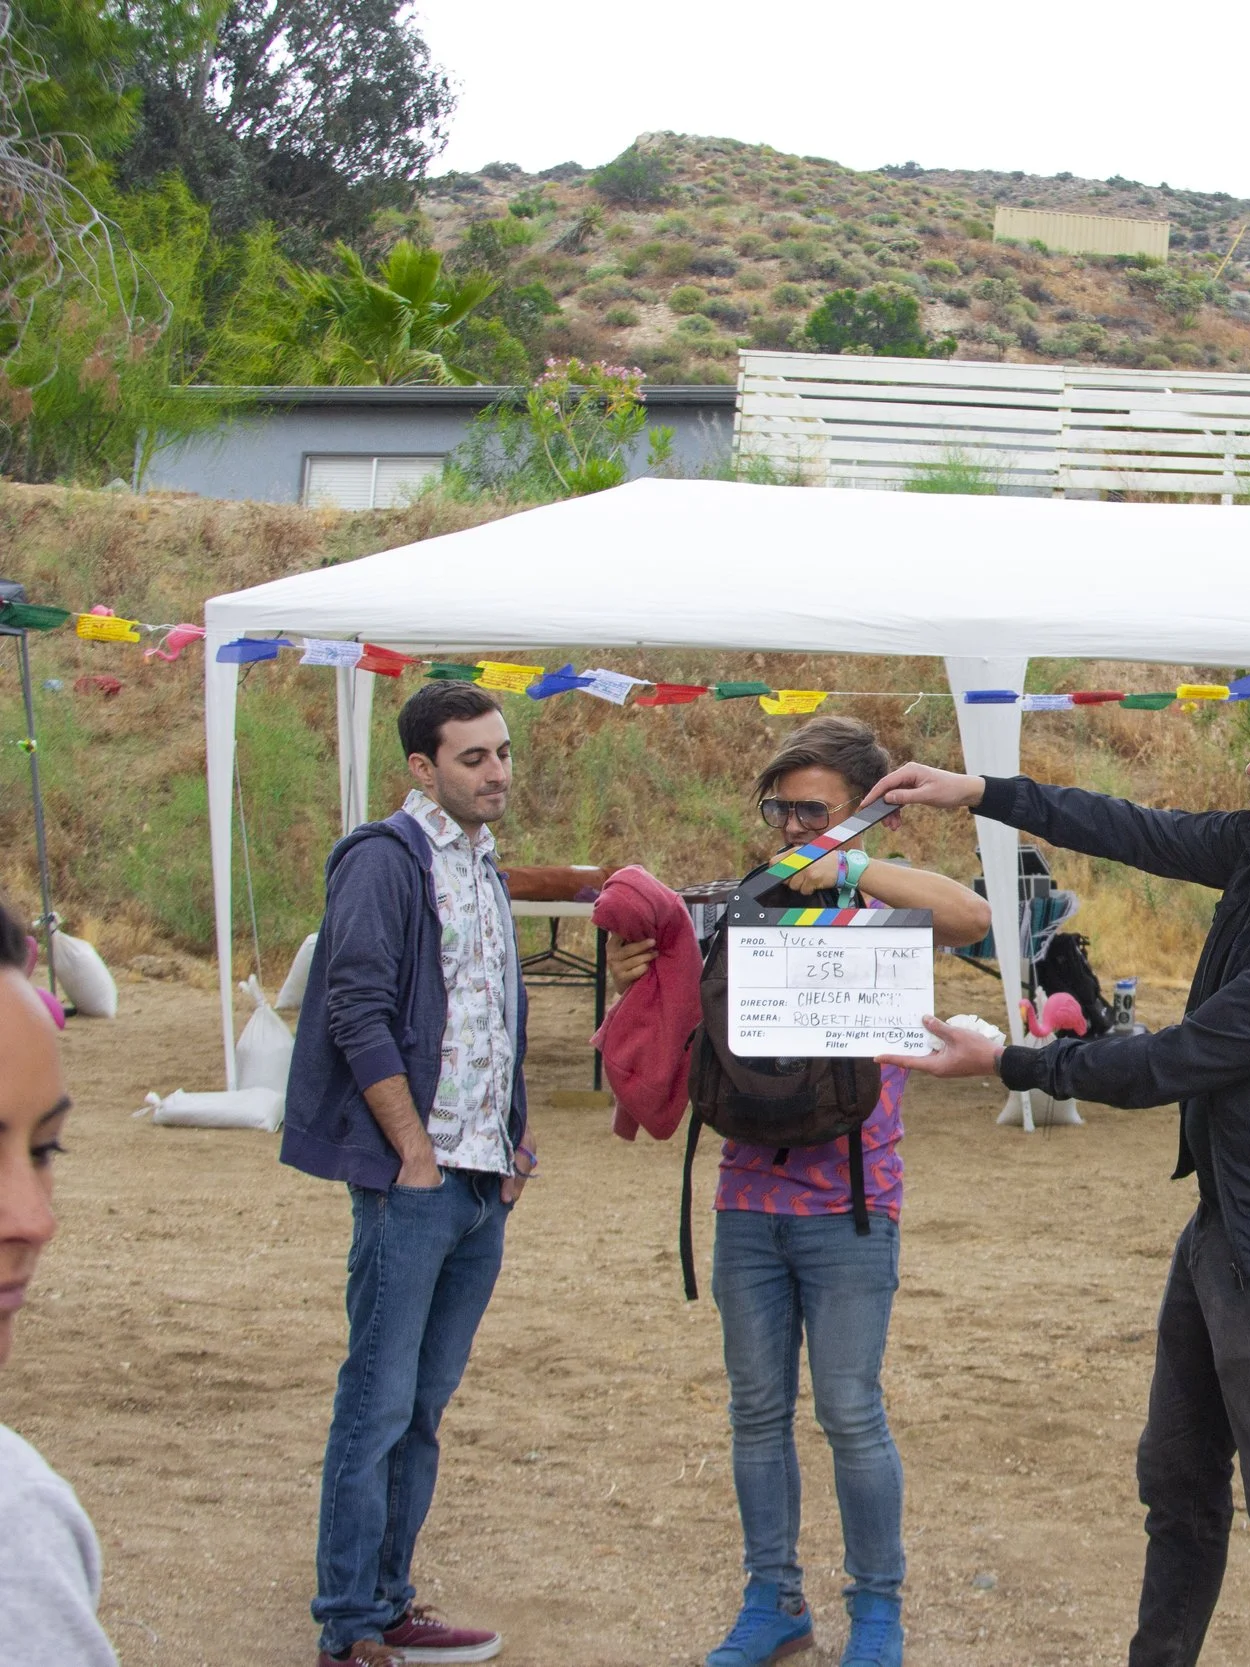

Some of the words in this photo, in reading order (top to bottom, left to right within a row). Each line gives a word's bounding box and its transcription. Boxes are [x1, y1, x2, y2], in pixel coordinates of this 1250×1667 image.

[740, 937, 767, 945] PROD.
[880, 949, 920, 958] TAKE
[807, 962, 844, 980] 25B
[797, 991, 851, 1007] CHELSEA
[857, 992, 902, 1008] MUR
[740, 1014, 781, 1022] CAMERA:
[793, 1011, 850, 1026] ROBERT
[825, 1030, 869, 1039] Day-Night
[873, 1030, 885, 1038] Int
[888, 1030, 902, 1038] Ext
[825, 1040, 849, 1048] Filter
[903, 1041, 924, 1050] Sync
